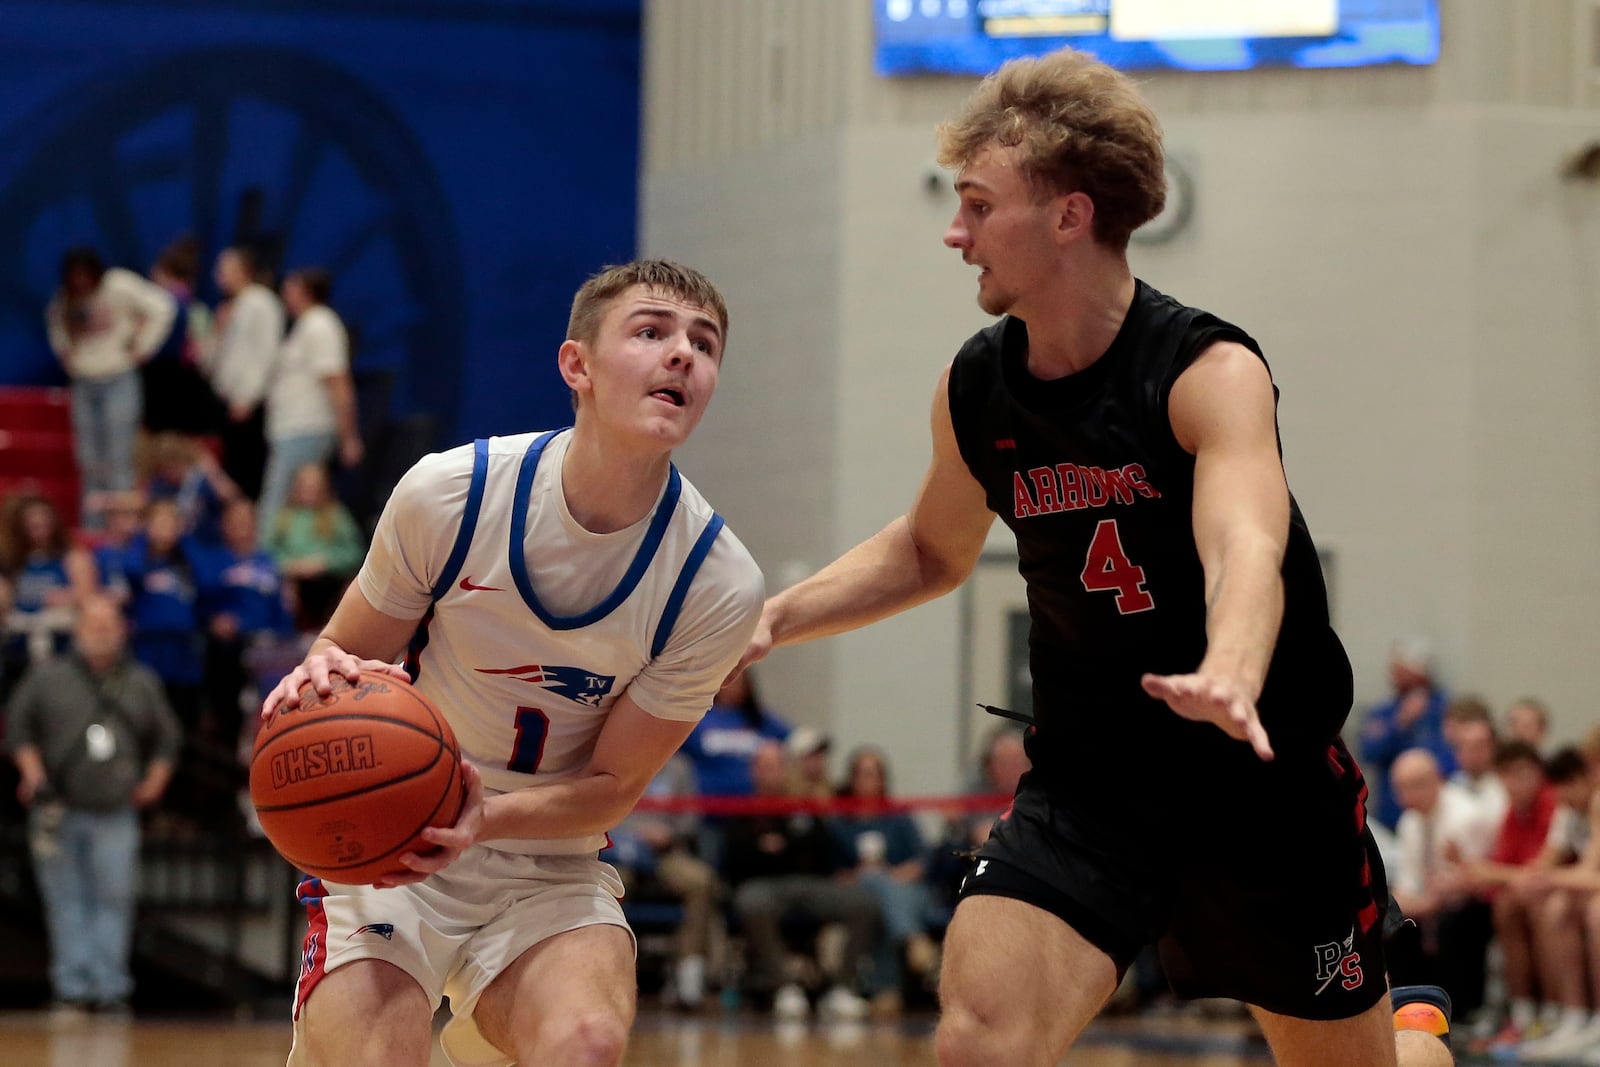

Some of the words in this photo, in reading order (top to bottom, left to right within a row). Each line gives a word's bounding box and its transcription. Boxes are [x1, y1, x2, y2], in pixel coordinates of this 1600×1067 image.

[1014, 463, 1161, 518] ARROWS
[1080, 519, 1155, 615] 4
[270, 734, 375, 790] OHSAA
[507, 706, 550, 774] 1
